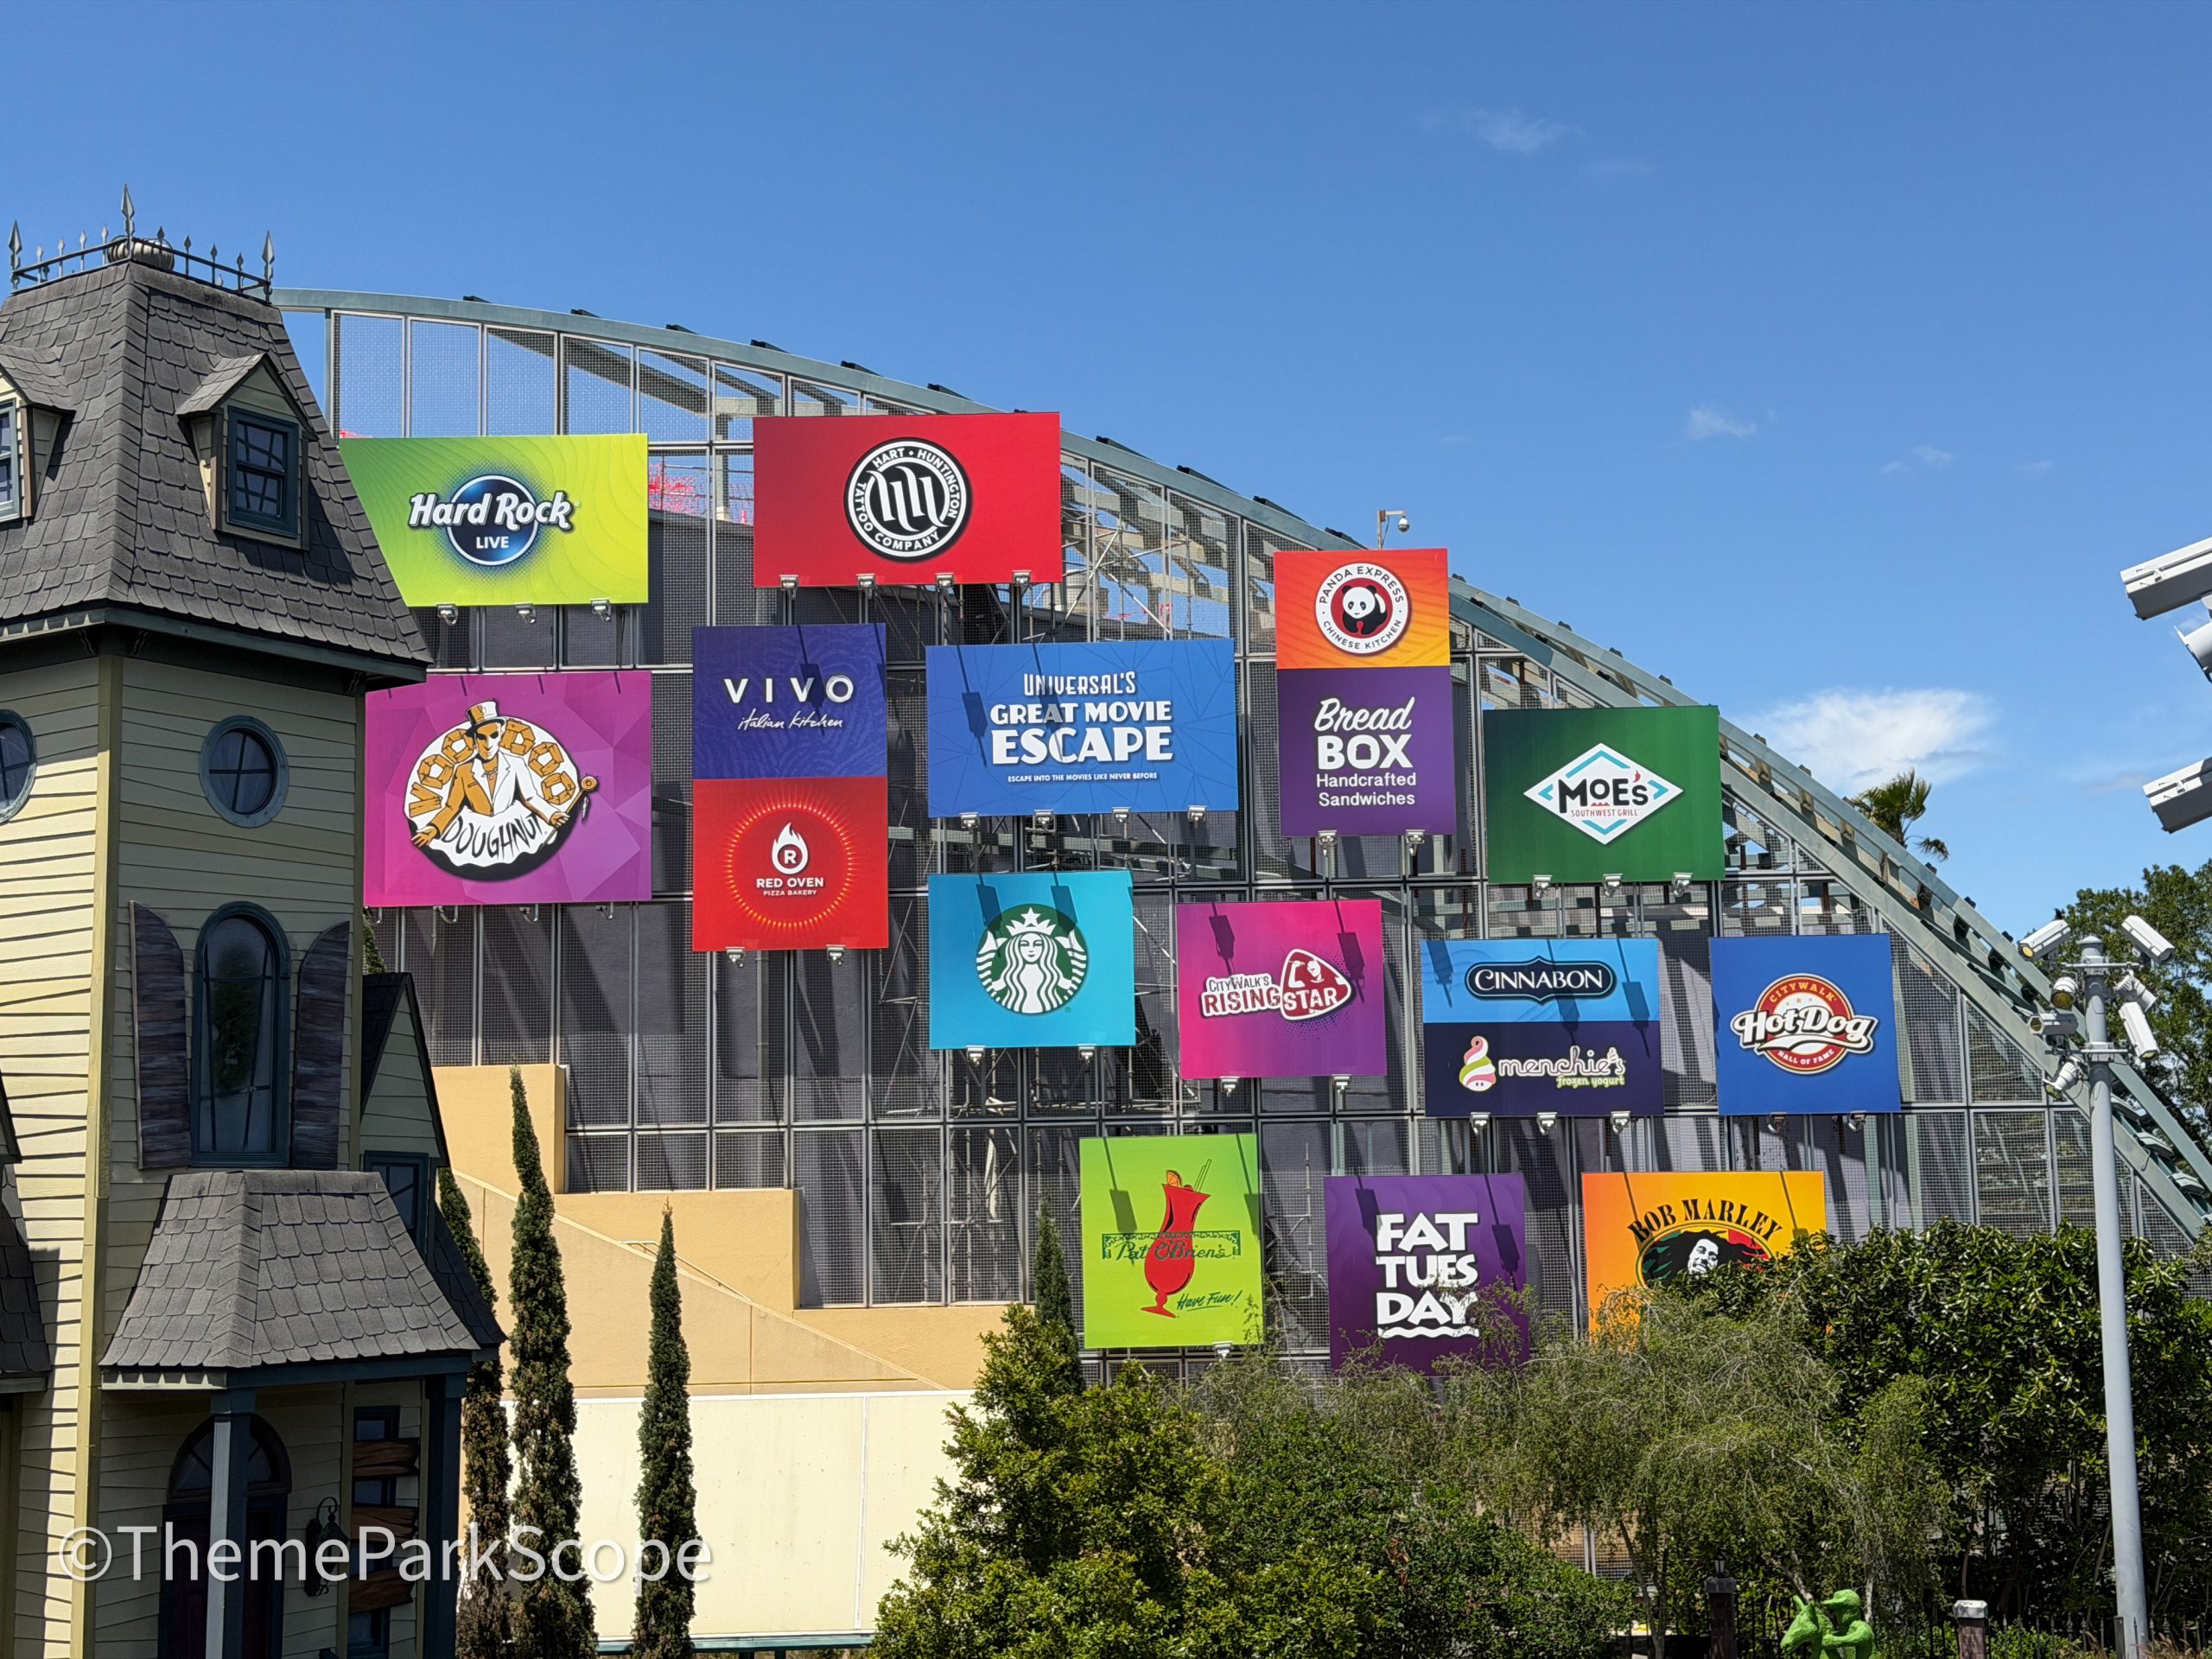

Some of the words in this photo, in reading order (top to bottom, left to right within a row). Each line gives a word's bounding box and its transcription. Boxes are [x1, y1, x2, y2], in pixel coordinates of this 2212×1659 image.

[872, 448, 905, 468] HART
[917, 448, 961, 519] HUNTINGTON
[409, 493, 492, 527] Hard
[494, 490, 572, 531] Rock
[855, 482, 874, 532] TATTOO
[874, 531, 940, 551] COMPANY
[475, 537, 510, 550] LIVE
[1319, 569, 1353, 604] PANDA
[1357, 566, 1404, 603] EXPRESS
[1323, 620, 1360, 650] CHINESE
[1365, 619, 1402, 650] KITCHEN
[723, 675, 855, 704] VIVO
[1024, 671, 1136, 696] UNIVERSAL'S
[990, 702, 1078, 725] GREAT
[1084, 701, 1173, 723] MOVIE
[1313, 696, 1415, 733] Bread
[991, 726, 1174, 765] ESCAPE
[1317, 734, 1414, 770] BOX
[1316, 772, 1417, 788] Handcrafted
[1319, 791, 1416, 807] Sandwiches
[1571, 809, 1616, 817] SOUTHWEST
[442, 814, 543, 861] DOUGHNUT
[784, 849, 797, 864] R
[756, 878, 784, 888] RED
[786, 877, 824, 887] OVEN
[1474, 969, 1604, 992] CINNABON
[1769, 982, 1836, 1003] CITYWALK
[1204, 987, 1281, 1014] RISING
[1284, 987, 1338, 1011] STAR
[1732, 1009, 1797, 1044] Hot
[1798, 1006, 1873, 1048] Dog
[1498, 1045, 1625, 1077] menchie's
[1777, 1050, 1798, 1065] HALL
[1813, 1049, 1835, 1065] FAME
[1556, 1075, 1590, 1089] frozen
[1591, 1075, 1625, 1089] yogurt
[1376, 1212, 1478, 1253] FAT
[1627, 1204, 1677, 1243] BOB
[1681, 1198, 1783, 1242] MARLEY
[1115, 1241, 1149, 1261] Pat
[1376, 1254, 1478, 1288] TUES
[1177, 1293, 1205, 1310] Have
[1206, 1289, 1243, 1306] Fun!
[1376, 1290, 1478, 1326] DAY
